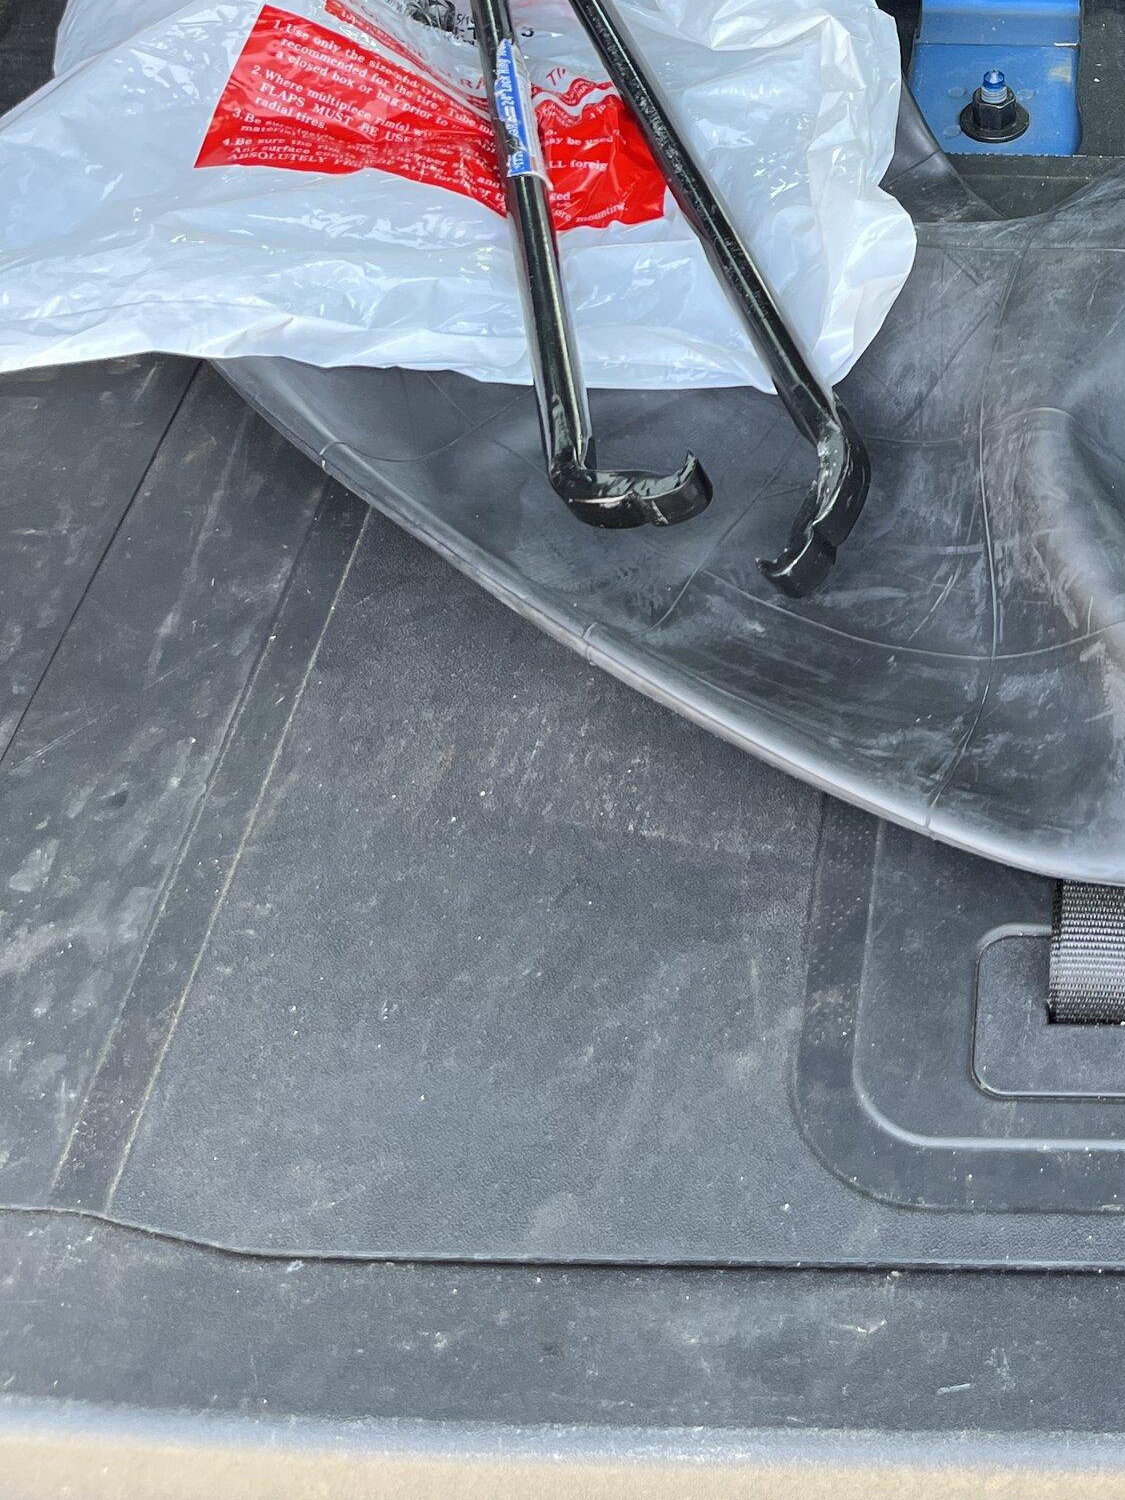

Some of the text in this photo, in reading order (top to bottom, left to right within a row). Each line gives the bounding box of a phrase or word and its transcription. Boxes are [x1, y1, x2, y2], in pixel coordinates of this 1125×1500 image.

[313, 35, 342, 53] only
[345, 48, 366, 64] the
[275, 51, 284, 60] a
[288, 54, 328, 77] closed
[332, 71, 356, 89] box
[358, 84, 374, 95] or
[376, 87, 399, 107] bag
[402, 101, 433, 120] prior
[435, 115, 449, 127] to
[280, 37, 367, 77] recommended
[370, 73, 390, 88] for
[394, 82, 414, 99] the
[447, 108, 476, 127] Tube
[254, 96, 294, 118] radial
[260, 81, 306, 108] FLAPS
[312, 102, 353, 128] MUST
[359, 119, 380, 138] BE
[307, 88, 372, 121] multipiece
[374, 114, 410, 134] rim(s)
[227, 151, 328, 165] ABSOLUTELY
[567, 136, 582, 146] be
